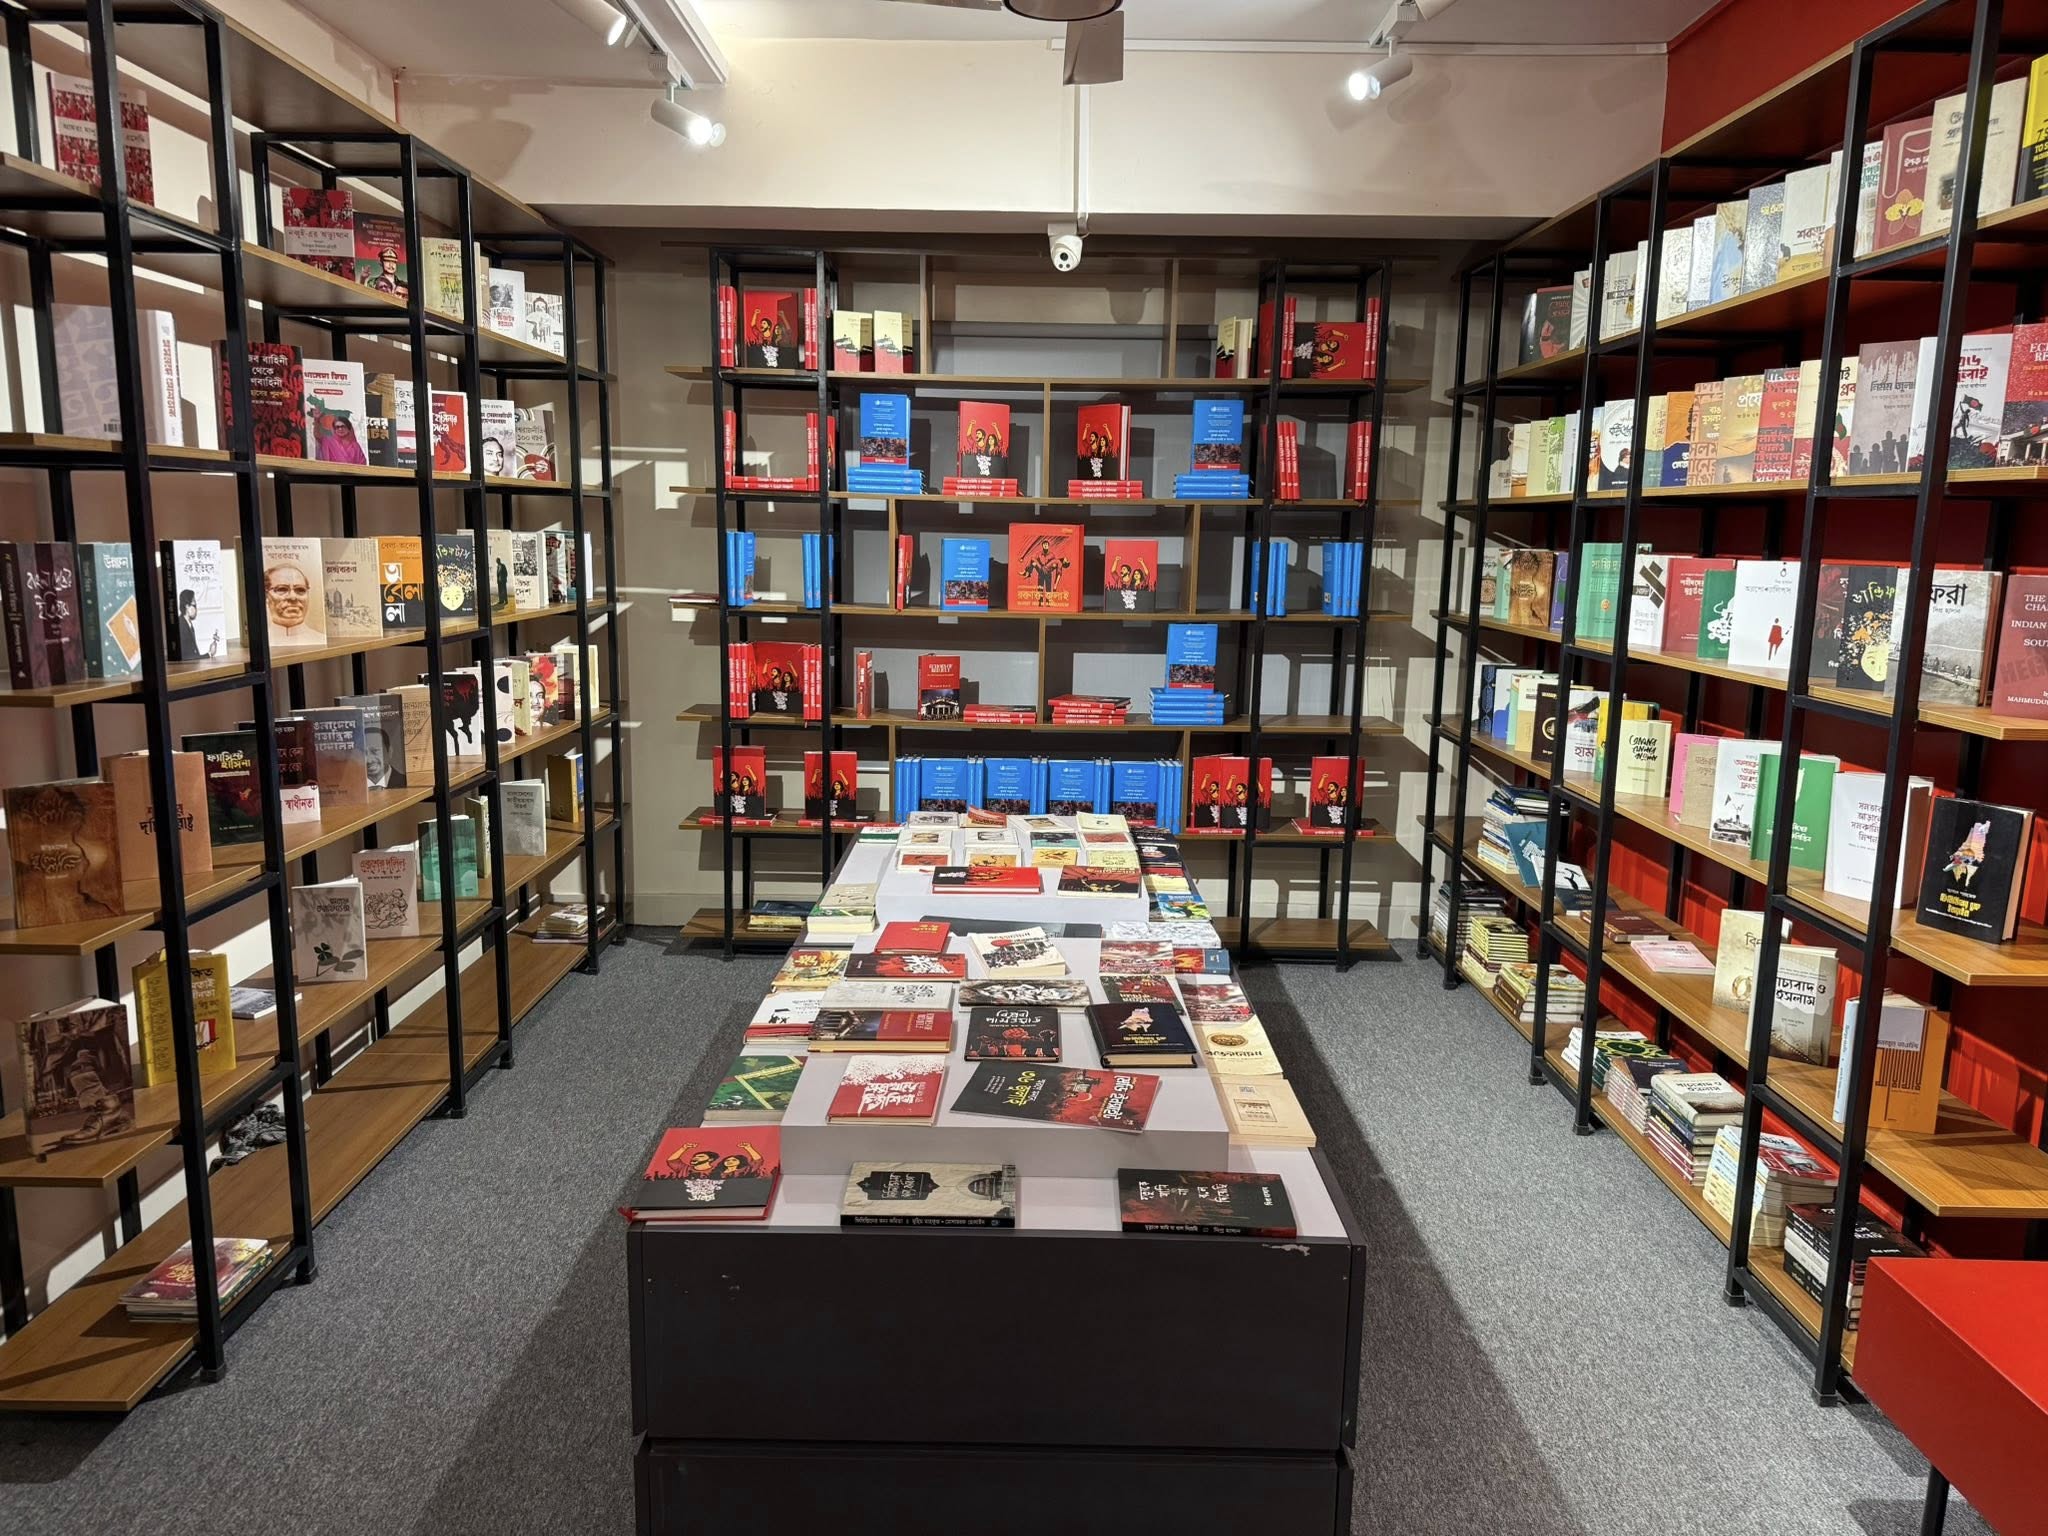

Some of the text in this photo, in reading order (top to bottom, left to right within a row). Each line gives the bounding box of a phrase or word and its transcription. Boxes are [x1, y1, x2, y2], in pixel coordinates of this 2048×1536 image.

[262, 354, 288, 367] বাহিনী
[252, 366, 274, 375] থেকে
[2024, 594, 2047, 603] THE
[2025, 603, 2048, 612] CHA
[2011, 620, 2047, 630] INDIAN
[285, 794, 316, 812] স্বাধীনতা
[1775, 976, 1827, 994] াচ্যবাদ ও
[1005, 1084, 1031, 1106] জুলাই
